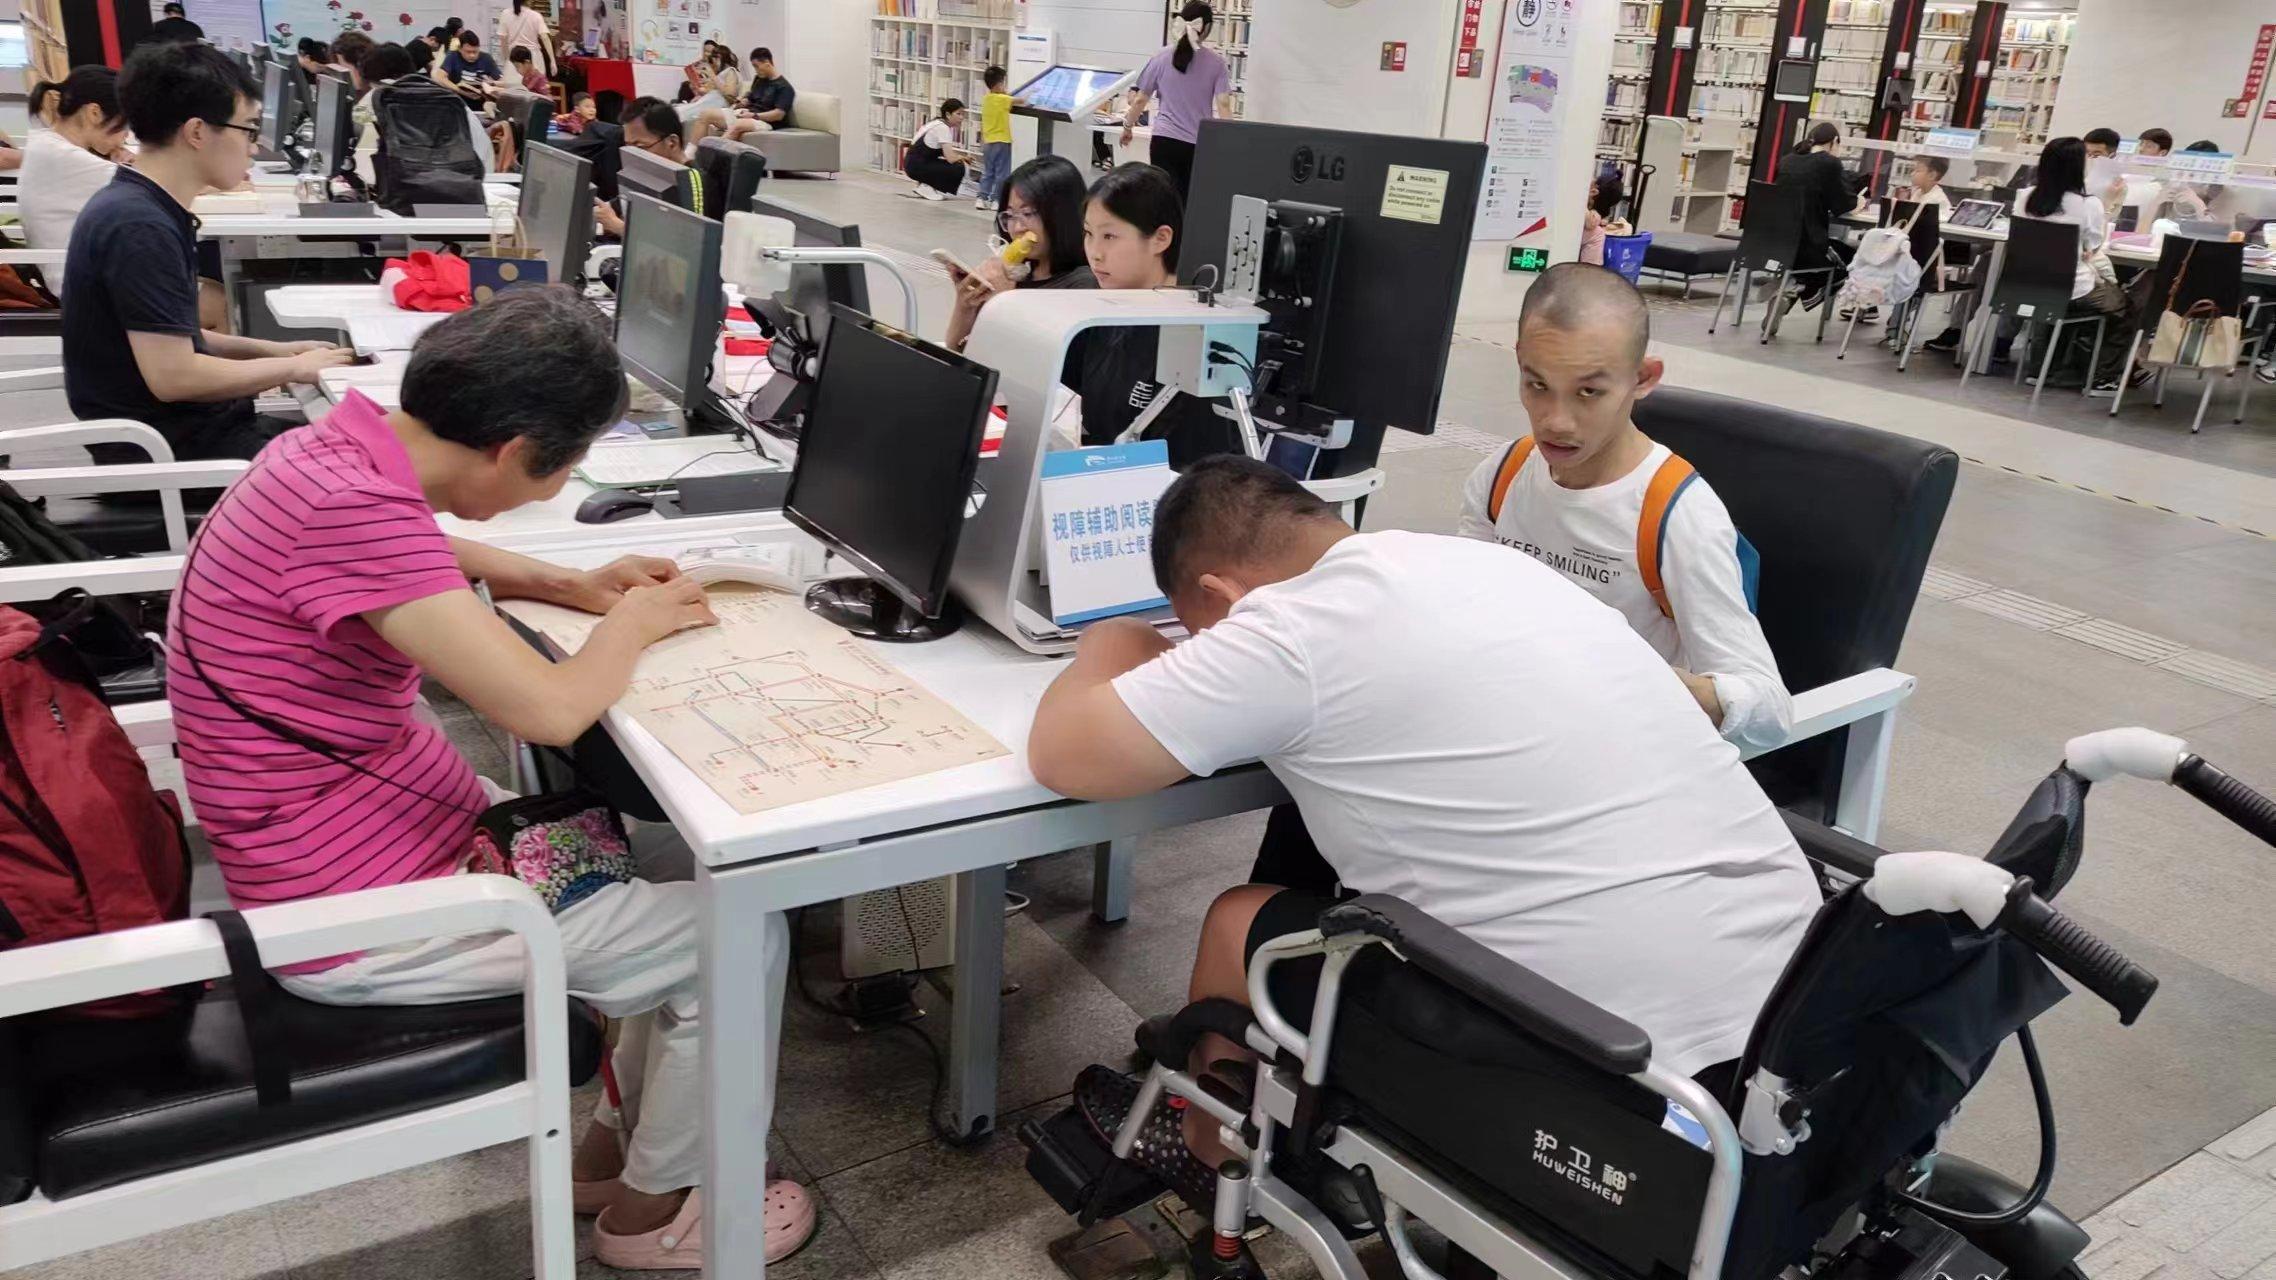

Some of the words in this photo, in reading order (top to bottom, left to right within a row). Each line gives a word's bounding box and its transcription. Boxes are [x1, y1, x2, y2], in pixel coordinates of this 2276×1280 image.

[1317, 154, 1345, 181] LG
[1052, 500, 1156, 541] 视障辅助阅读
[1532, 1150, 1623, 1206] HUWEISHEN
